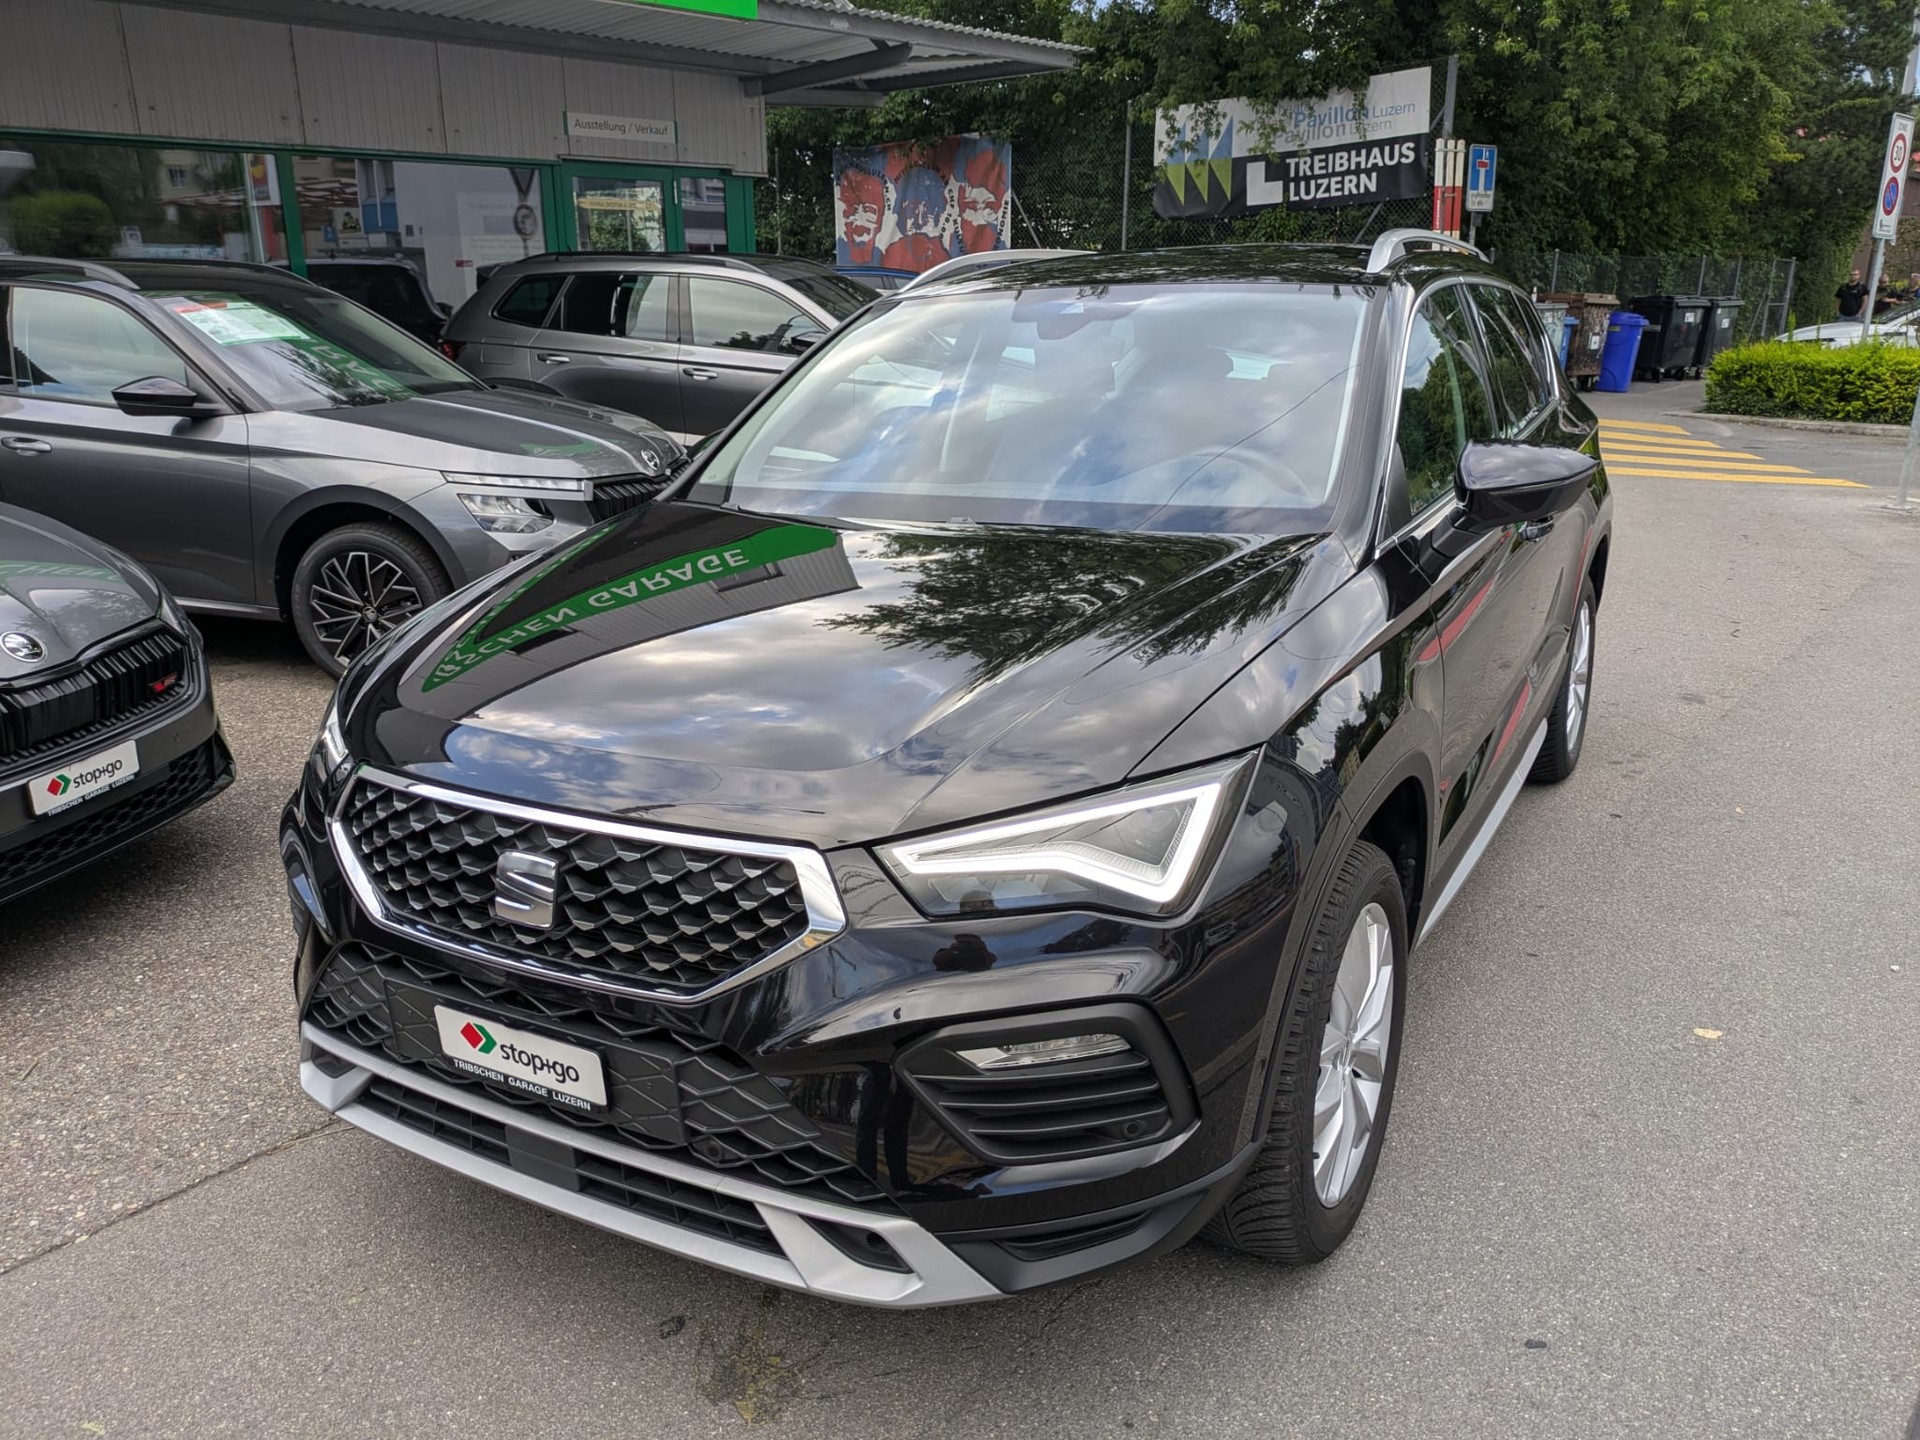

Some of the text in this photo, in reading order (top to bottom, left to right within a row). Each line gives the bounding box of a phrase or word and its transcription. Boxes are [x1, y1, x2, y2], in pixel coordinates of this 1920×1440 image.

[574, 118, 626, 135] Ausstellung
[634, 123, 668, 135] Verkauf
[1293, 105, 1369, 129] Pavillon
[1372, 102, 1416, 118] Luzern
[1285, 142, 1416, 178] TREIBHAUS
[1289, 171, 1378, 201] LUZERN
[73, 759, 122, 788] stop+go
[48, 774, 135, 816] TRIBSCHEN GARAGE LUZERN
[500, 1043, 580, 1084] stop+go
[453, 1058, 591, 1111] TRIBSCHEN GARAGE LUZERN
